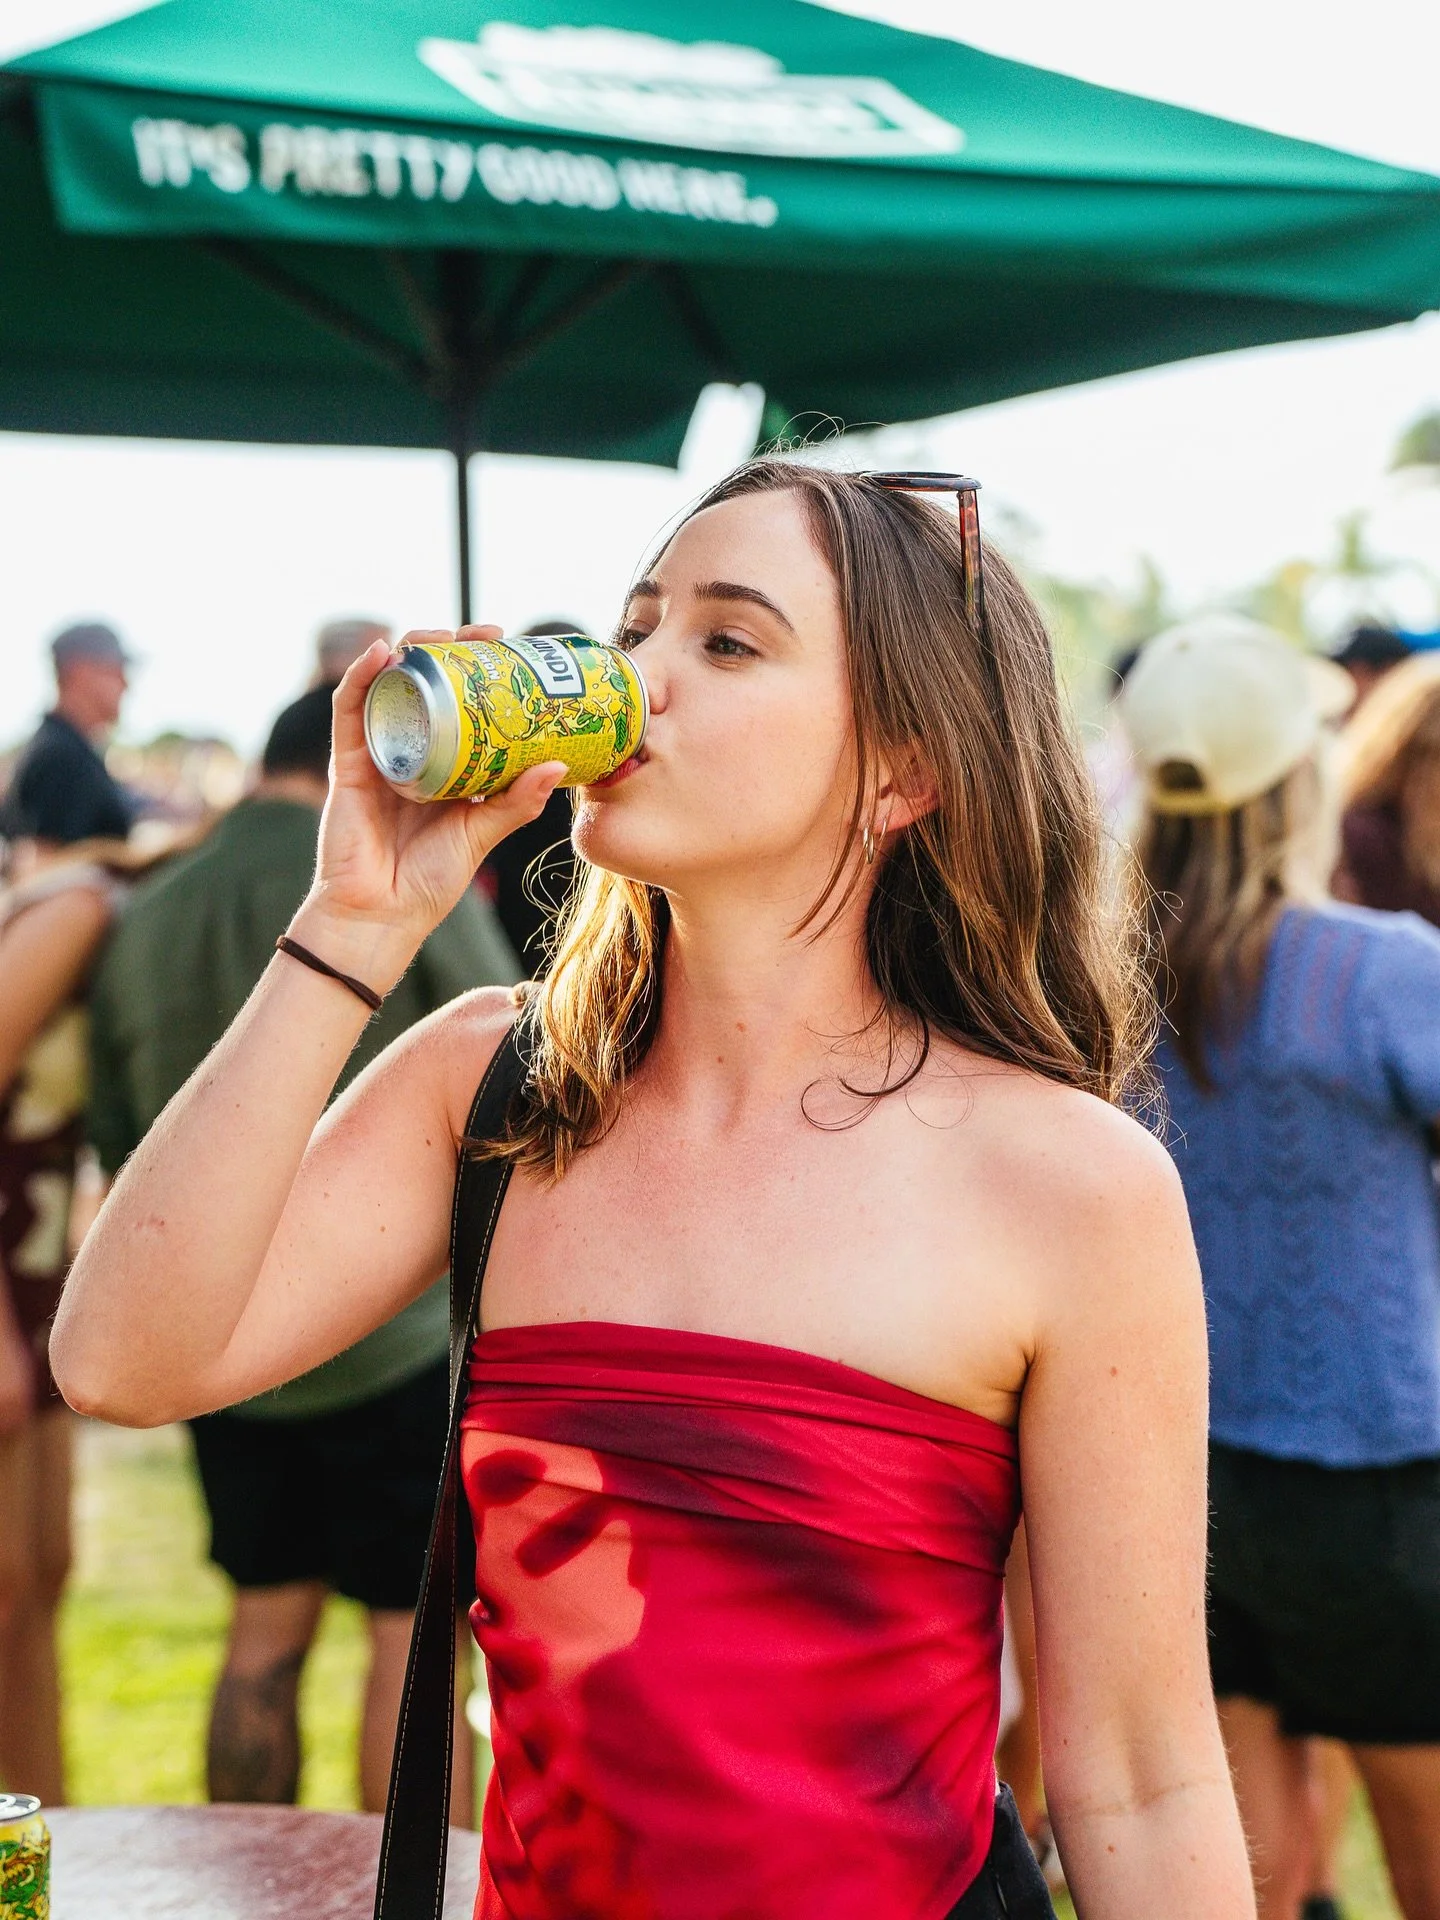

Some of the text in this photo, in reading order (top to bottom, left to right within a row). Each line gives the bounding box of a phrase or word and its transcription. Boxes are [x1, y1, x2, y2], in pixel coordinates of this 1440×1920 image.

[261, 123, 474, 201] PRETTY
[476, 142, 621, 211] GOOD
[523, 742, 538, 770] ALCO
